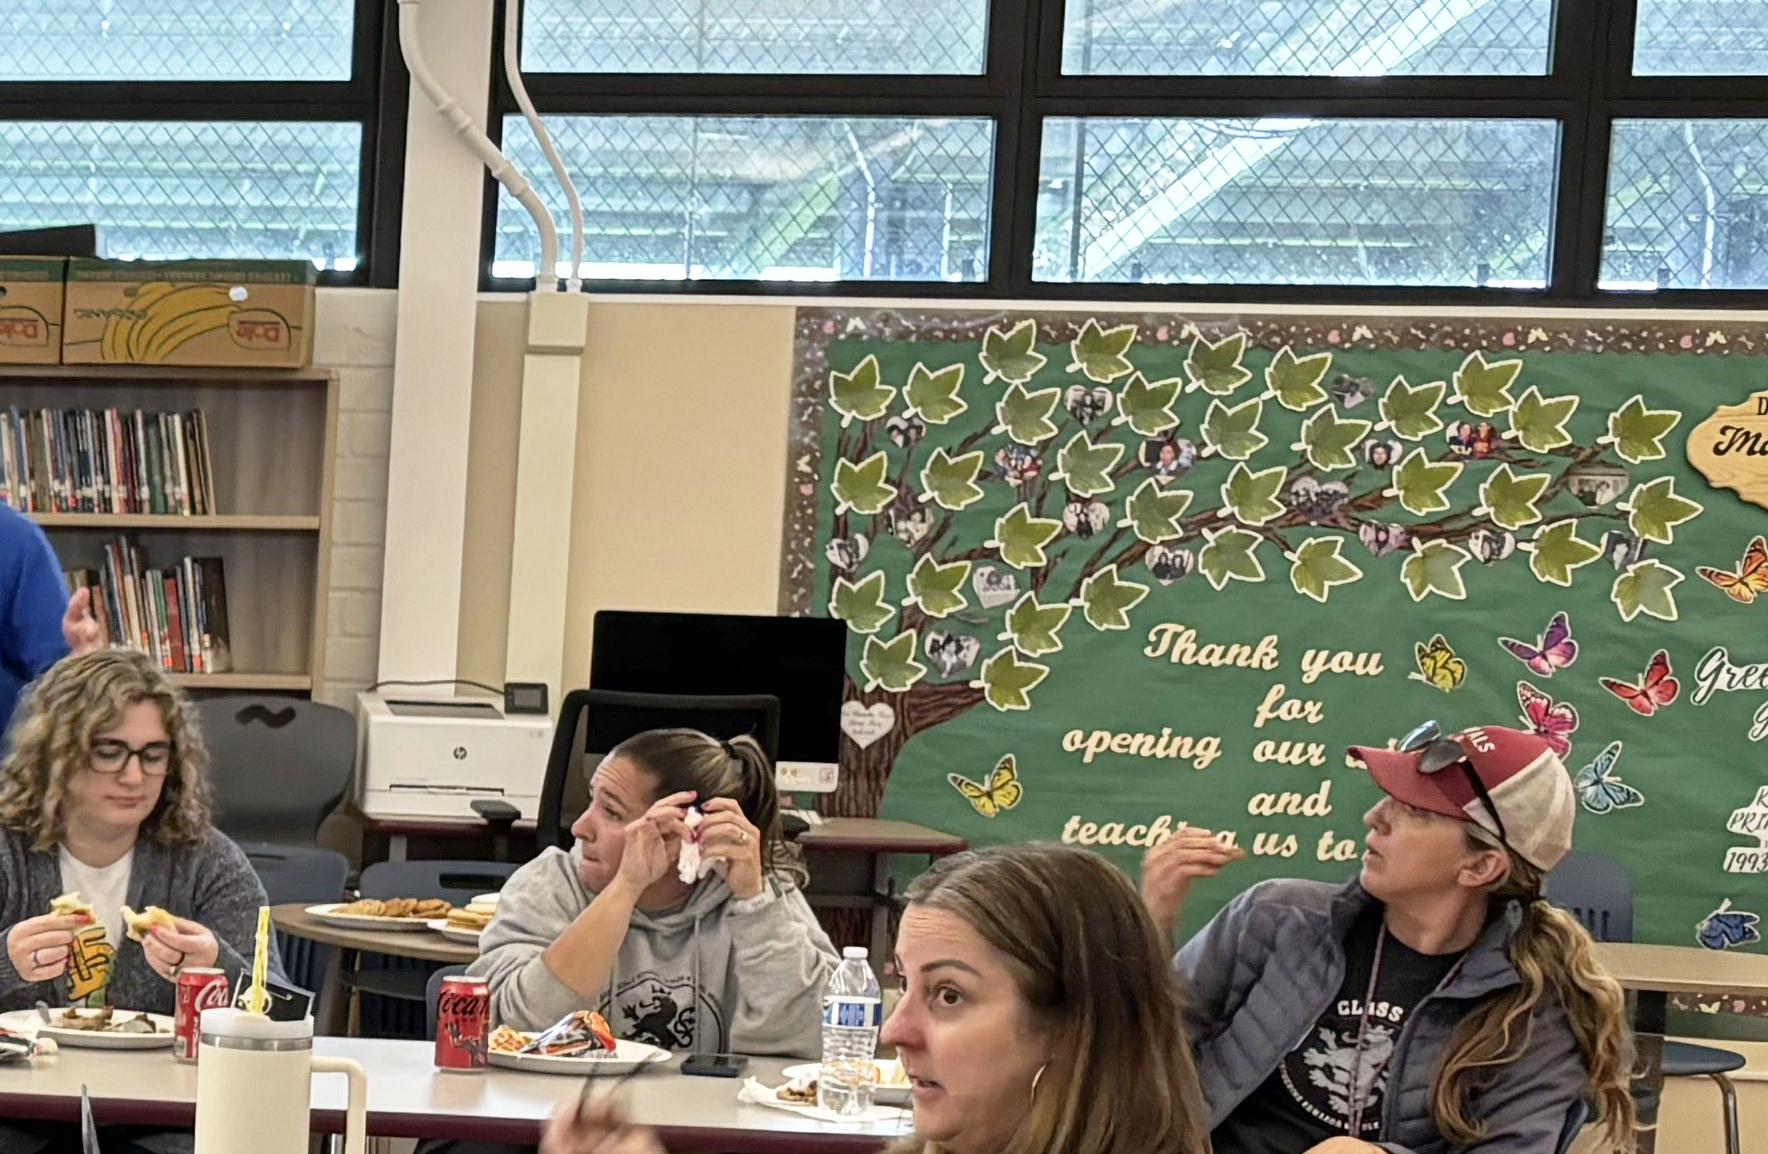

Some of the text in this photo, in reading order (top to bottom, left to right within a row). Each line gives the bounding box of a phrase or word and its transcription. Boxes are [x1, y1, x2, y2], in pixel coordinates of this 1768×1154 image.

[1144, 623, 1384, 684] Thank you
[1253, 684, 1324, 728] for
[1062, 727, 1222, 770] opening
[1252, 738, 1326, 767] our
[1247, 780, 1332, 817] and
[1252, 831, 1298, 858] us
[1316, 829, 1359, 862] to
